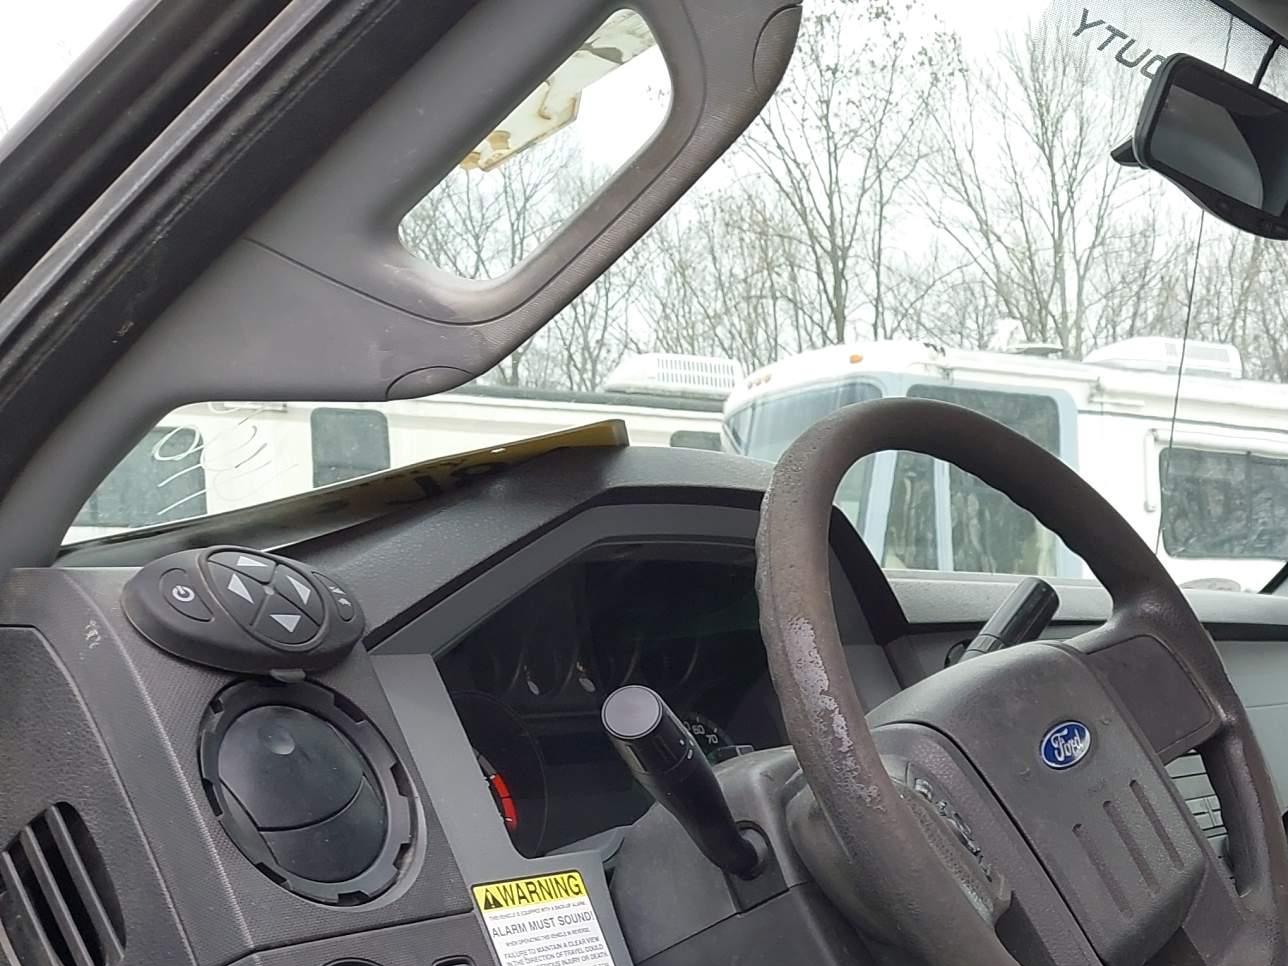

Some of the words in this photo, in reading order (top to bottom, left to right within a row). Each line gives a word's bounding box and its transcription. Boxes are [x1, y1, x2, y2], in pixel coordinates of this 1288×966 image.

[705, 734, 719, 745] 70
[1049, 725, 1087, 764] Ford
[496, 875, 583, 906] WARNING
[491, 922, 528, 938] ALARM
[528, 917, 556, 932] MUST
[558, 910, 594, 926] SOUND!
[525, 953, 555, 963] DIRECTION
[563, 948, 583, 956] TRAVEL
[537, 943, 562, 952] MAINTAIN
